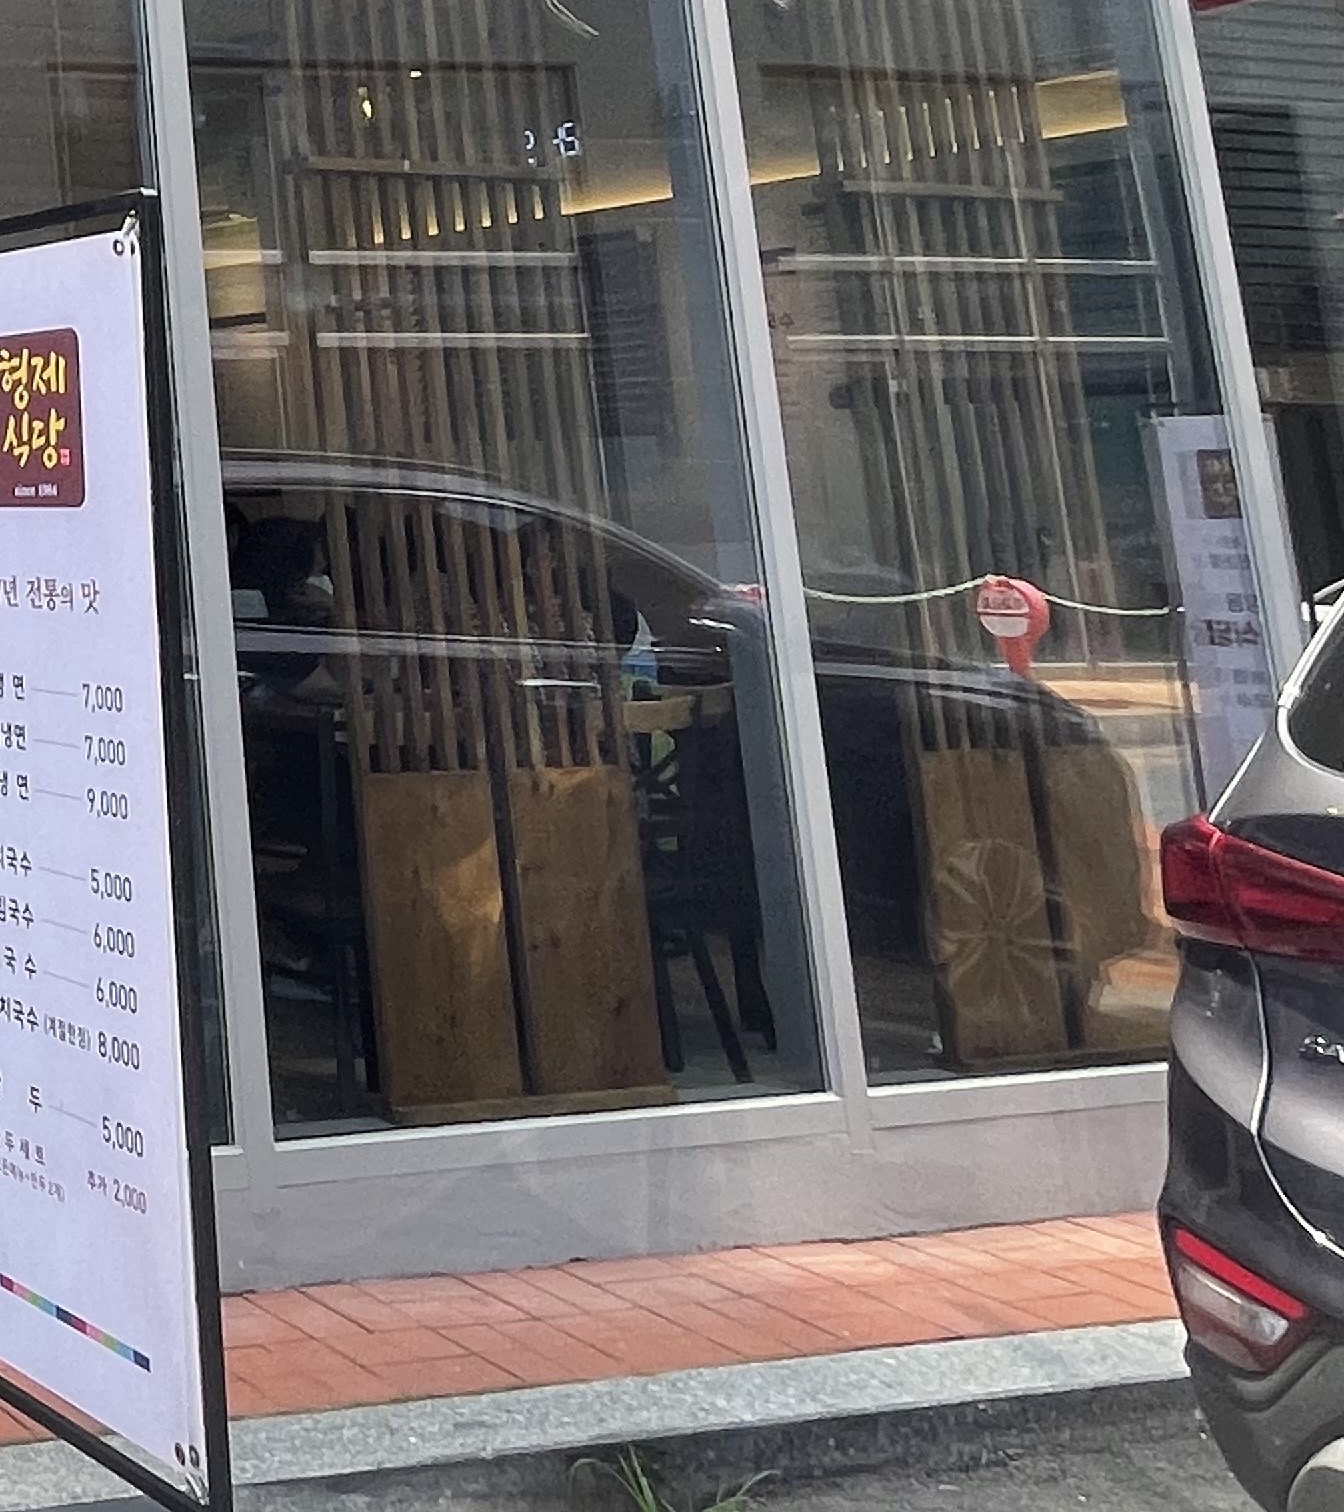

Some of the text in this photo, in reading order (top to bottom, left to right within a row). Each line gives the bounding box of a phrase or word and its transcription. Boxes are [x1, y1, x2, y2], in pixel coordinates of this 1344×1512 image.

[2, 408, 65, 468] 식당
[26, 576, 73, 611] 전통의
[80, 579, 99, 615] 맛
[82, 683, 123, 713] 7,000
[84, 735, 126, 766] 7,000
[87, 788, 128, 820] 9,000
[90, 868, 132, 902] 5,000
[93, 922, 135, 958] 6,000
[96, 976, 137, 1014] 6,000
[98, 1031, 140, 1070] 8,000
[102, 1115, 144, 1158] 5,000
[112, 1178, 147, 1215] 2,000
